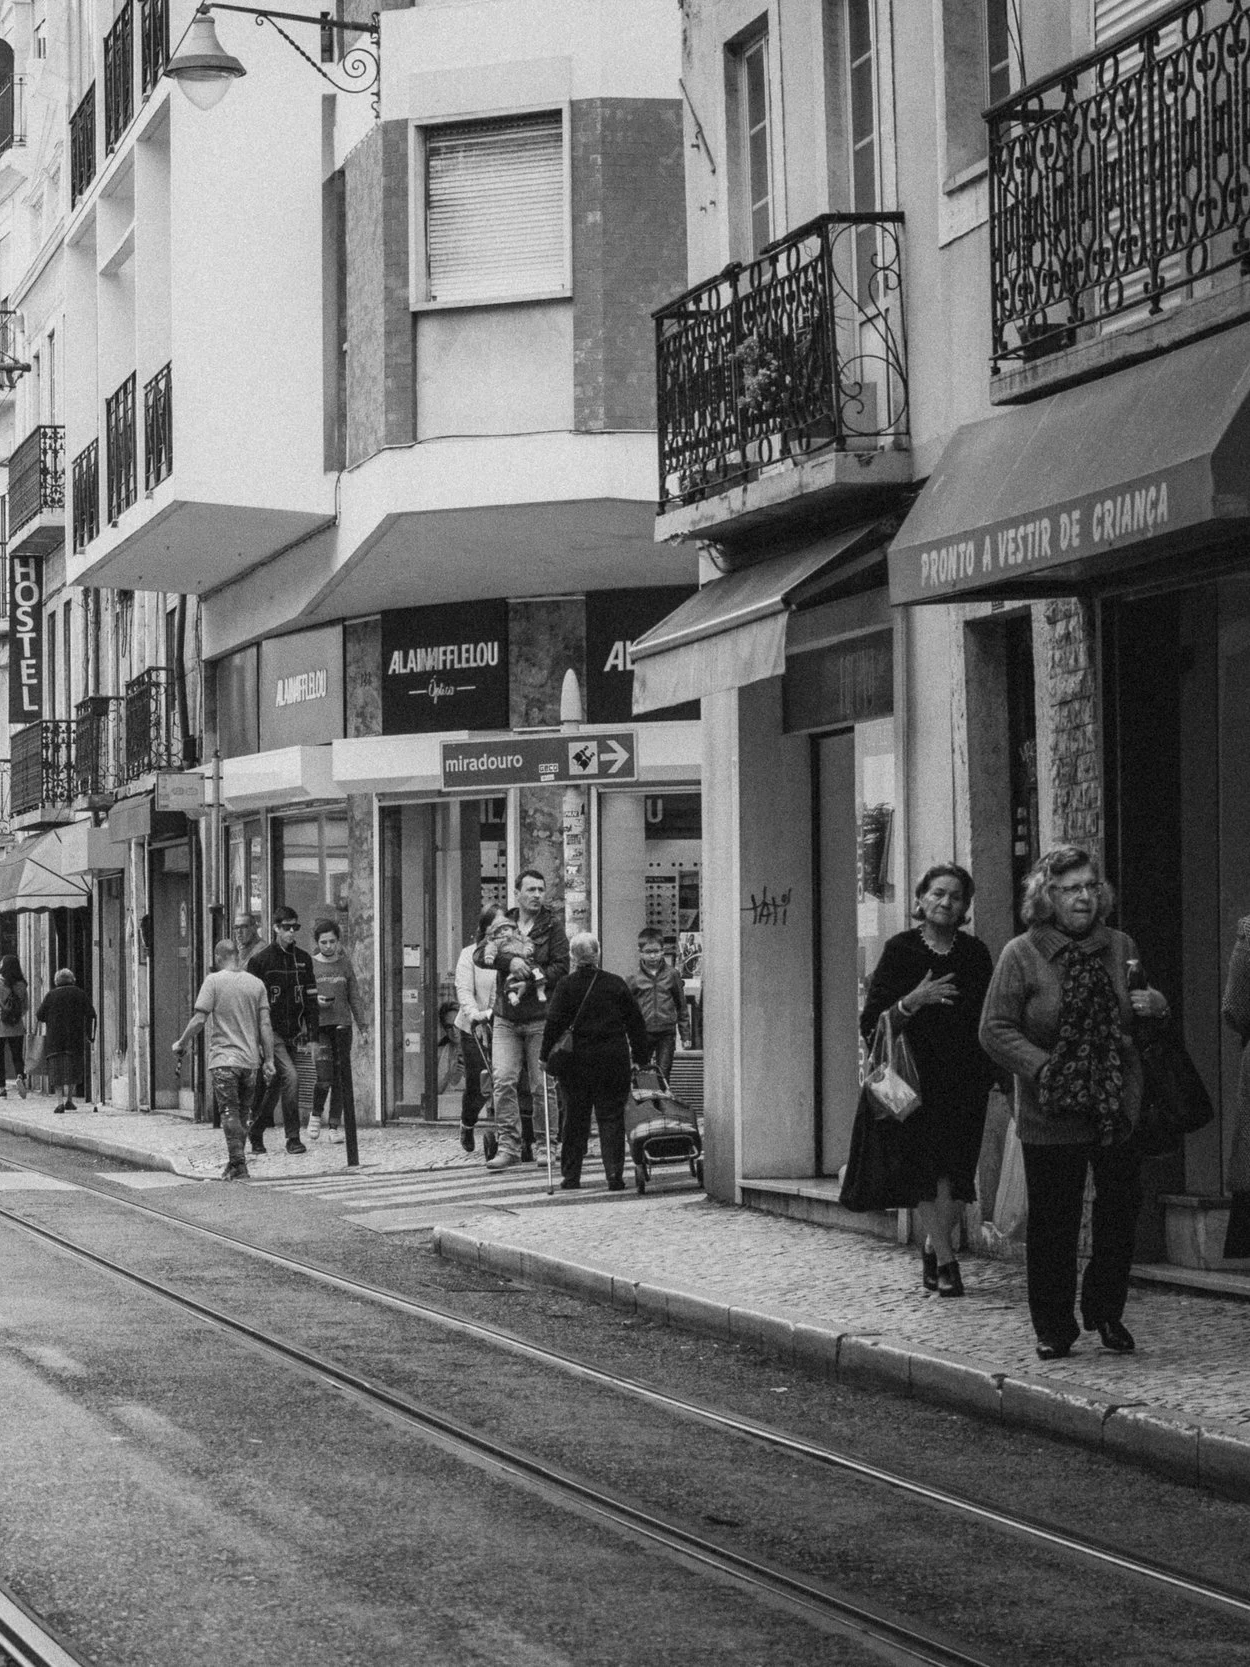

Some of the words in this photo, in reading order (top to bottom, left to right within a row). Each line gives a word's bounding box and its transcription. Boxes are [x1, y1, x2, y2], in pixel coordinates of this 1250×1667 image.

[920, 541, 975, 588] PRONTO
[982, 535, 992, 572] A
[997, 518, 1051, 568] VESTIR
[1059, 509, 1081, 551] DE
[1092, 482, 1168, 543] CRIANÇA
[13, 557, 40, 712] HOSTEL
[445, 754, 523, 772] miradouro
